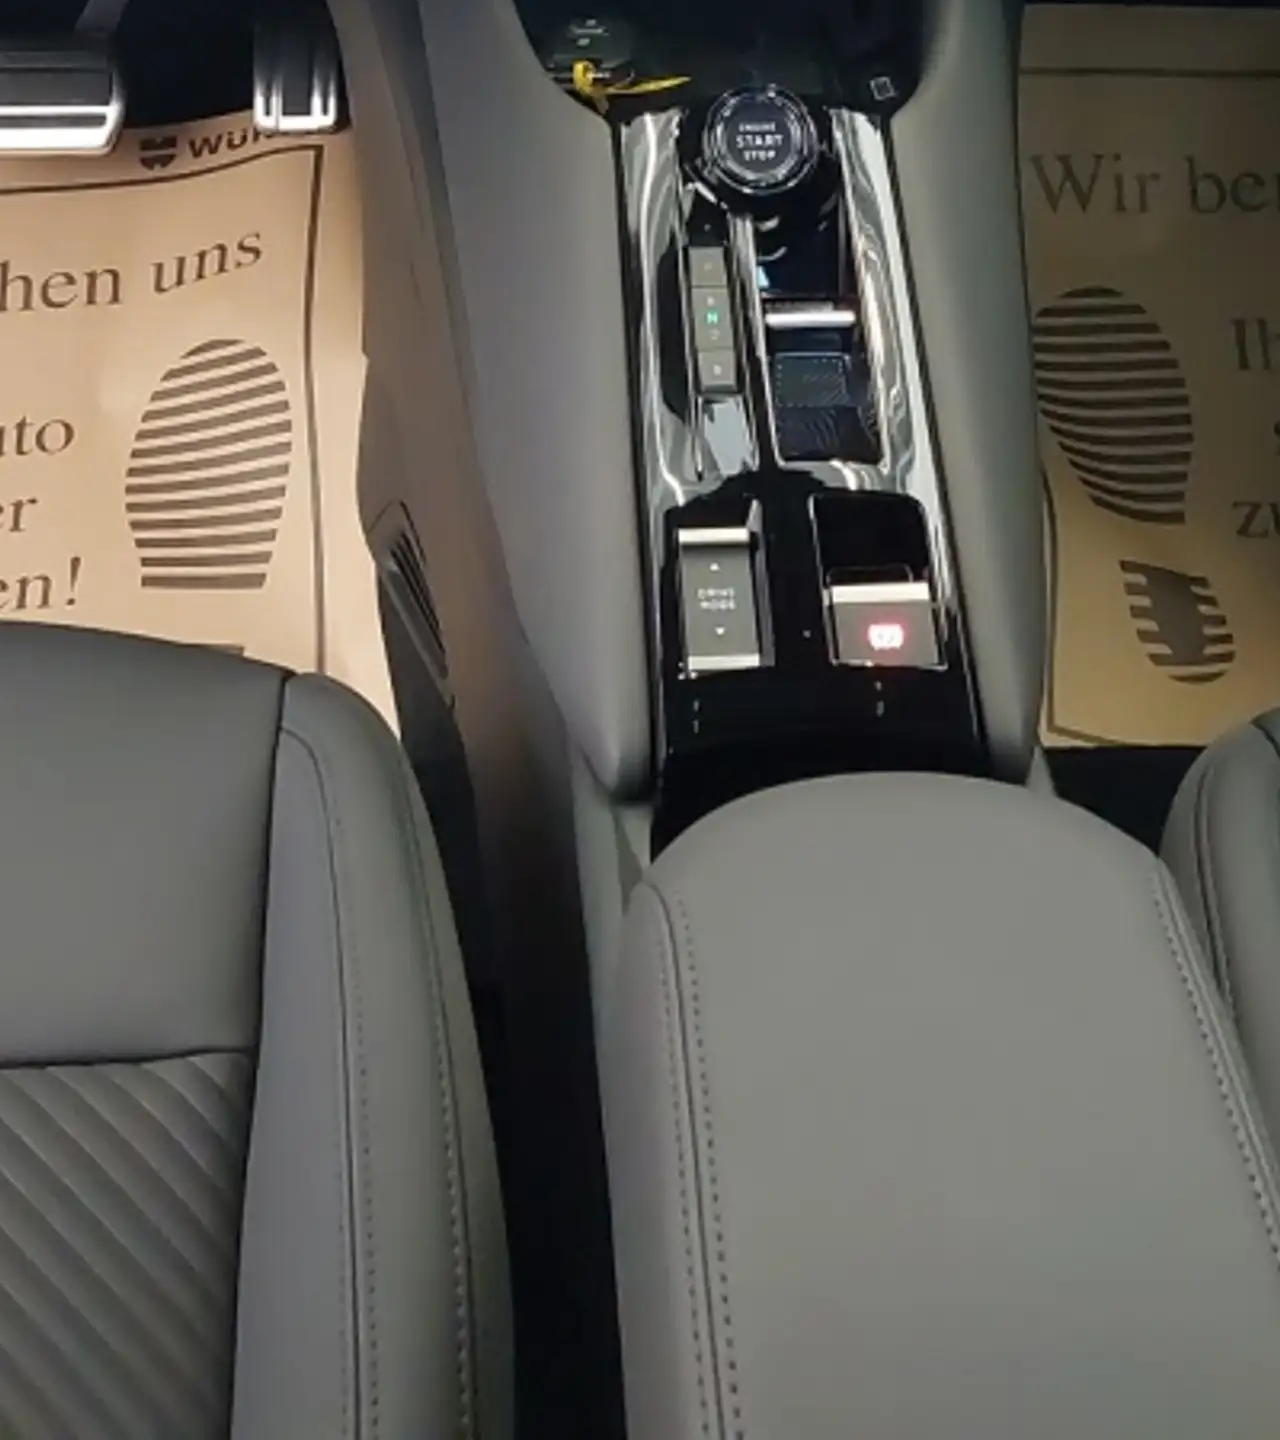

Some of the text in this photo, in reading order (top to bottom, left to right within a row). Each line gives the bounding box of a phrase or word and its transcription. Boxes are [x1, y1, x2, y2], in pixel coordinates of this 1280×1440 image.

[735, 134, 784, 149] START
[1028, 151, 1161, 216] Wir
[150, 230, 263, 296] uns
